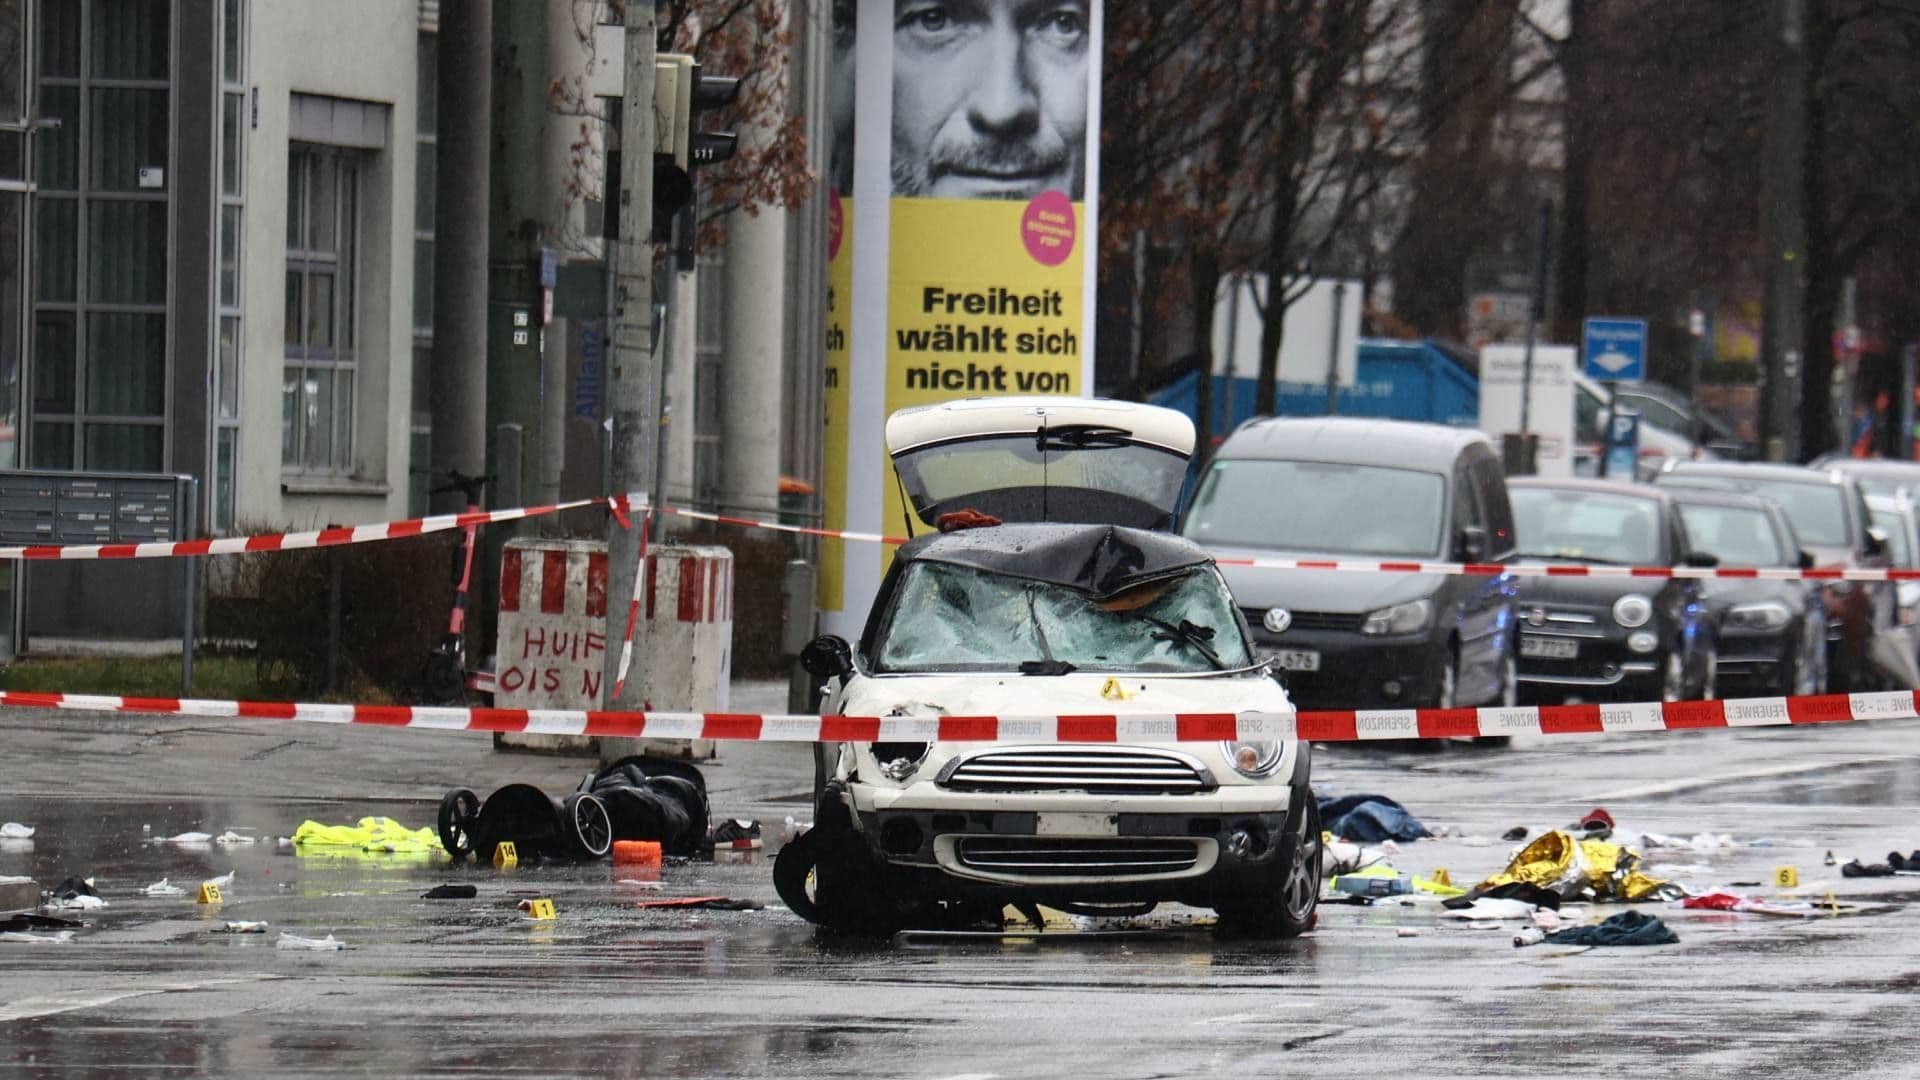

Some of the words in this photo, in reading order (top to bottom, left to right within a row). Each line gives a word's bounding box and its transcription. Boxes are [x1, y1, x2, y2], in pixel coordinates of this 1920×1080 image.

[923, 287, 1062, 316] Freiheit
[896, 325, 1007, 353] wählt
[1016, 327, 1077, 355] sich
[906, 362, 1007, 392] nicht
[1015, 371, 1069, 393] von
[503, 844, 514, 857] 14
[1780, 870, 1789, 882] 6
[206, 886, 219, 898] 15
[542, 903, 549, 916] 1
